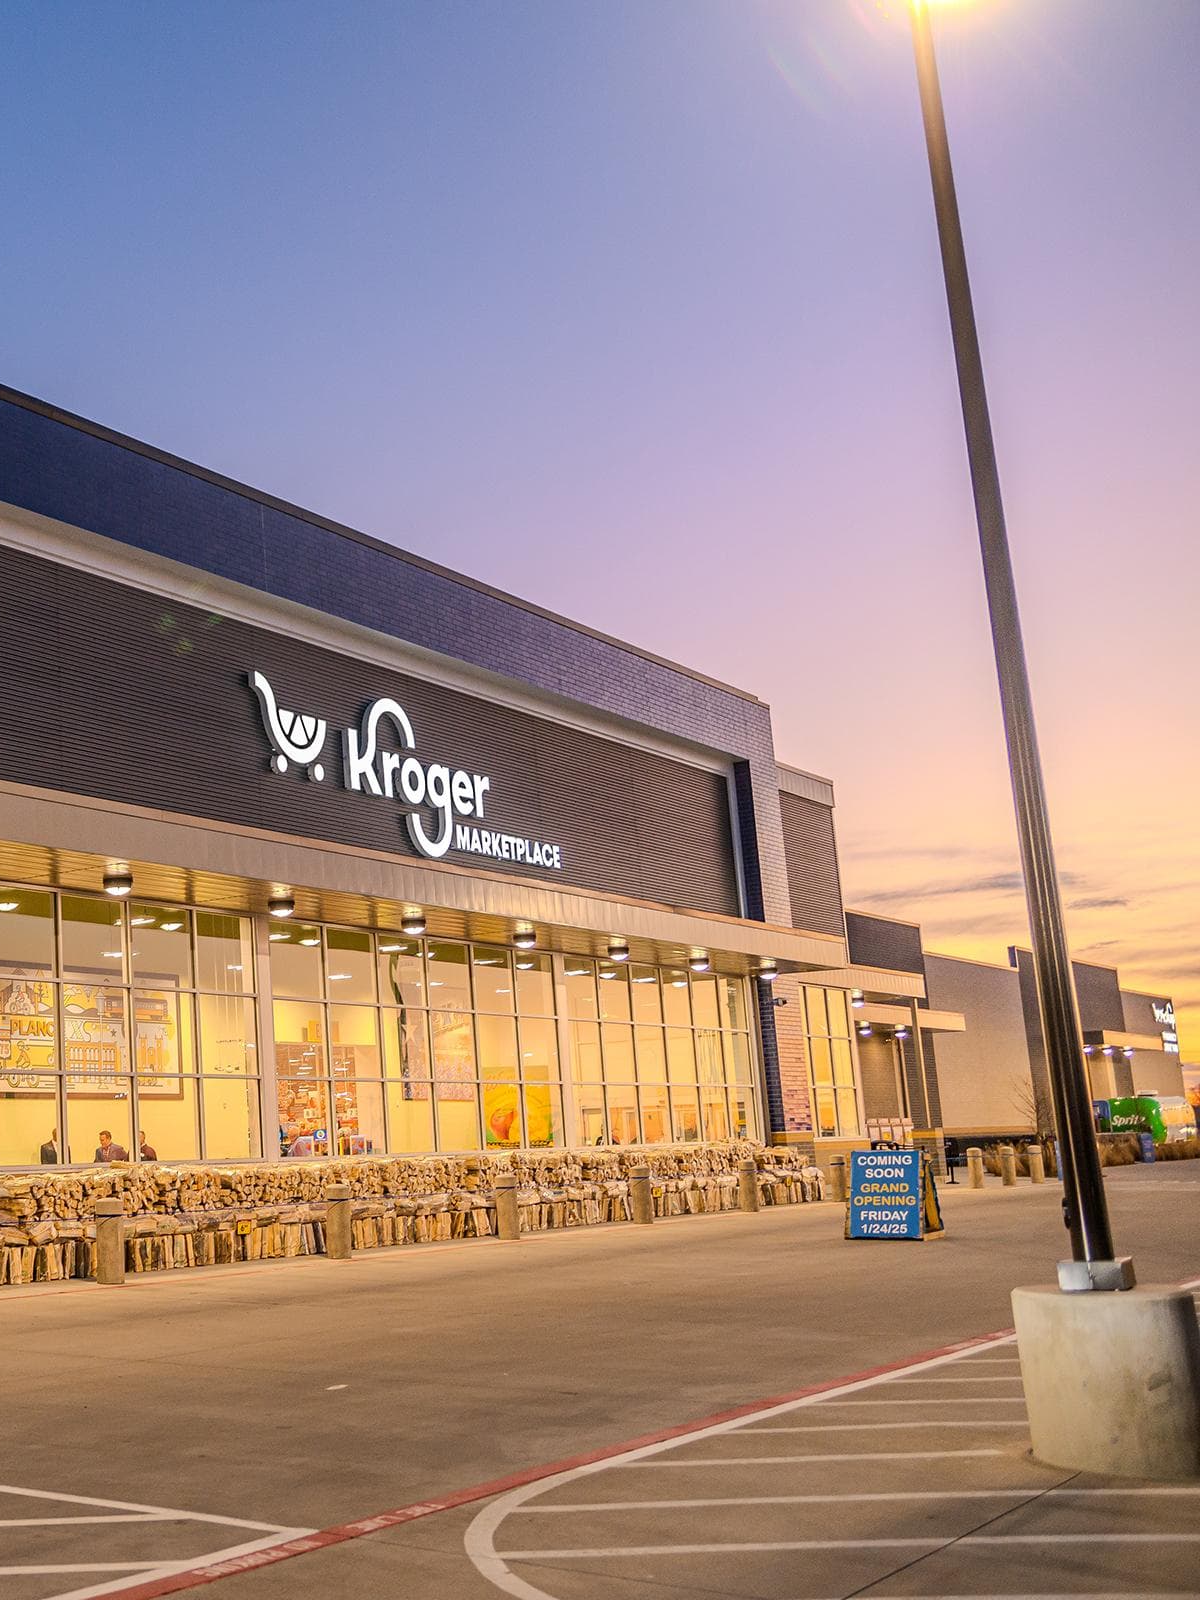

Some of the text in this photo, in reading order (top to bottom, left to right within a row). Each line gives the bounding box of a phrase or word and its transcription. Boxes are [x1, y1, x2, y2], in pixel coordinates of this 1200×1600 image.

[344, 697, 490, 858] Kroger
[456, 825, 562, 869] MARKETPLACE
[857, 1155, 913, 1166] COMING
[865, 1168, 904, 1178] SOON
[860, 1183, 909, 1193] GRAND
[853, 1195, 916, 1206] OPENING
[860, 1210, 909, 1221] FRIDAY
[861, 1223, 908, 1234] 1/24/25
